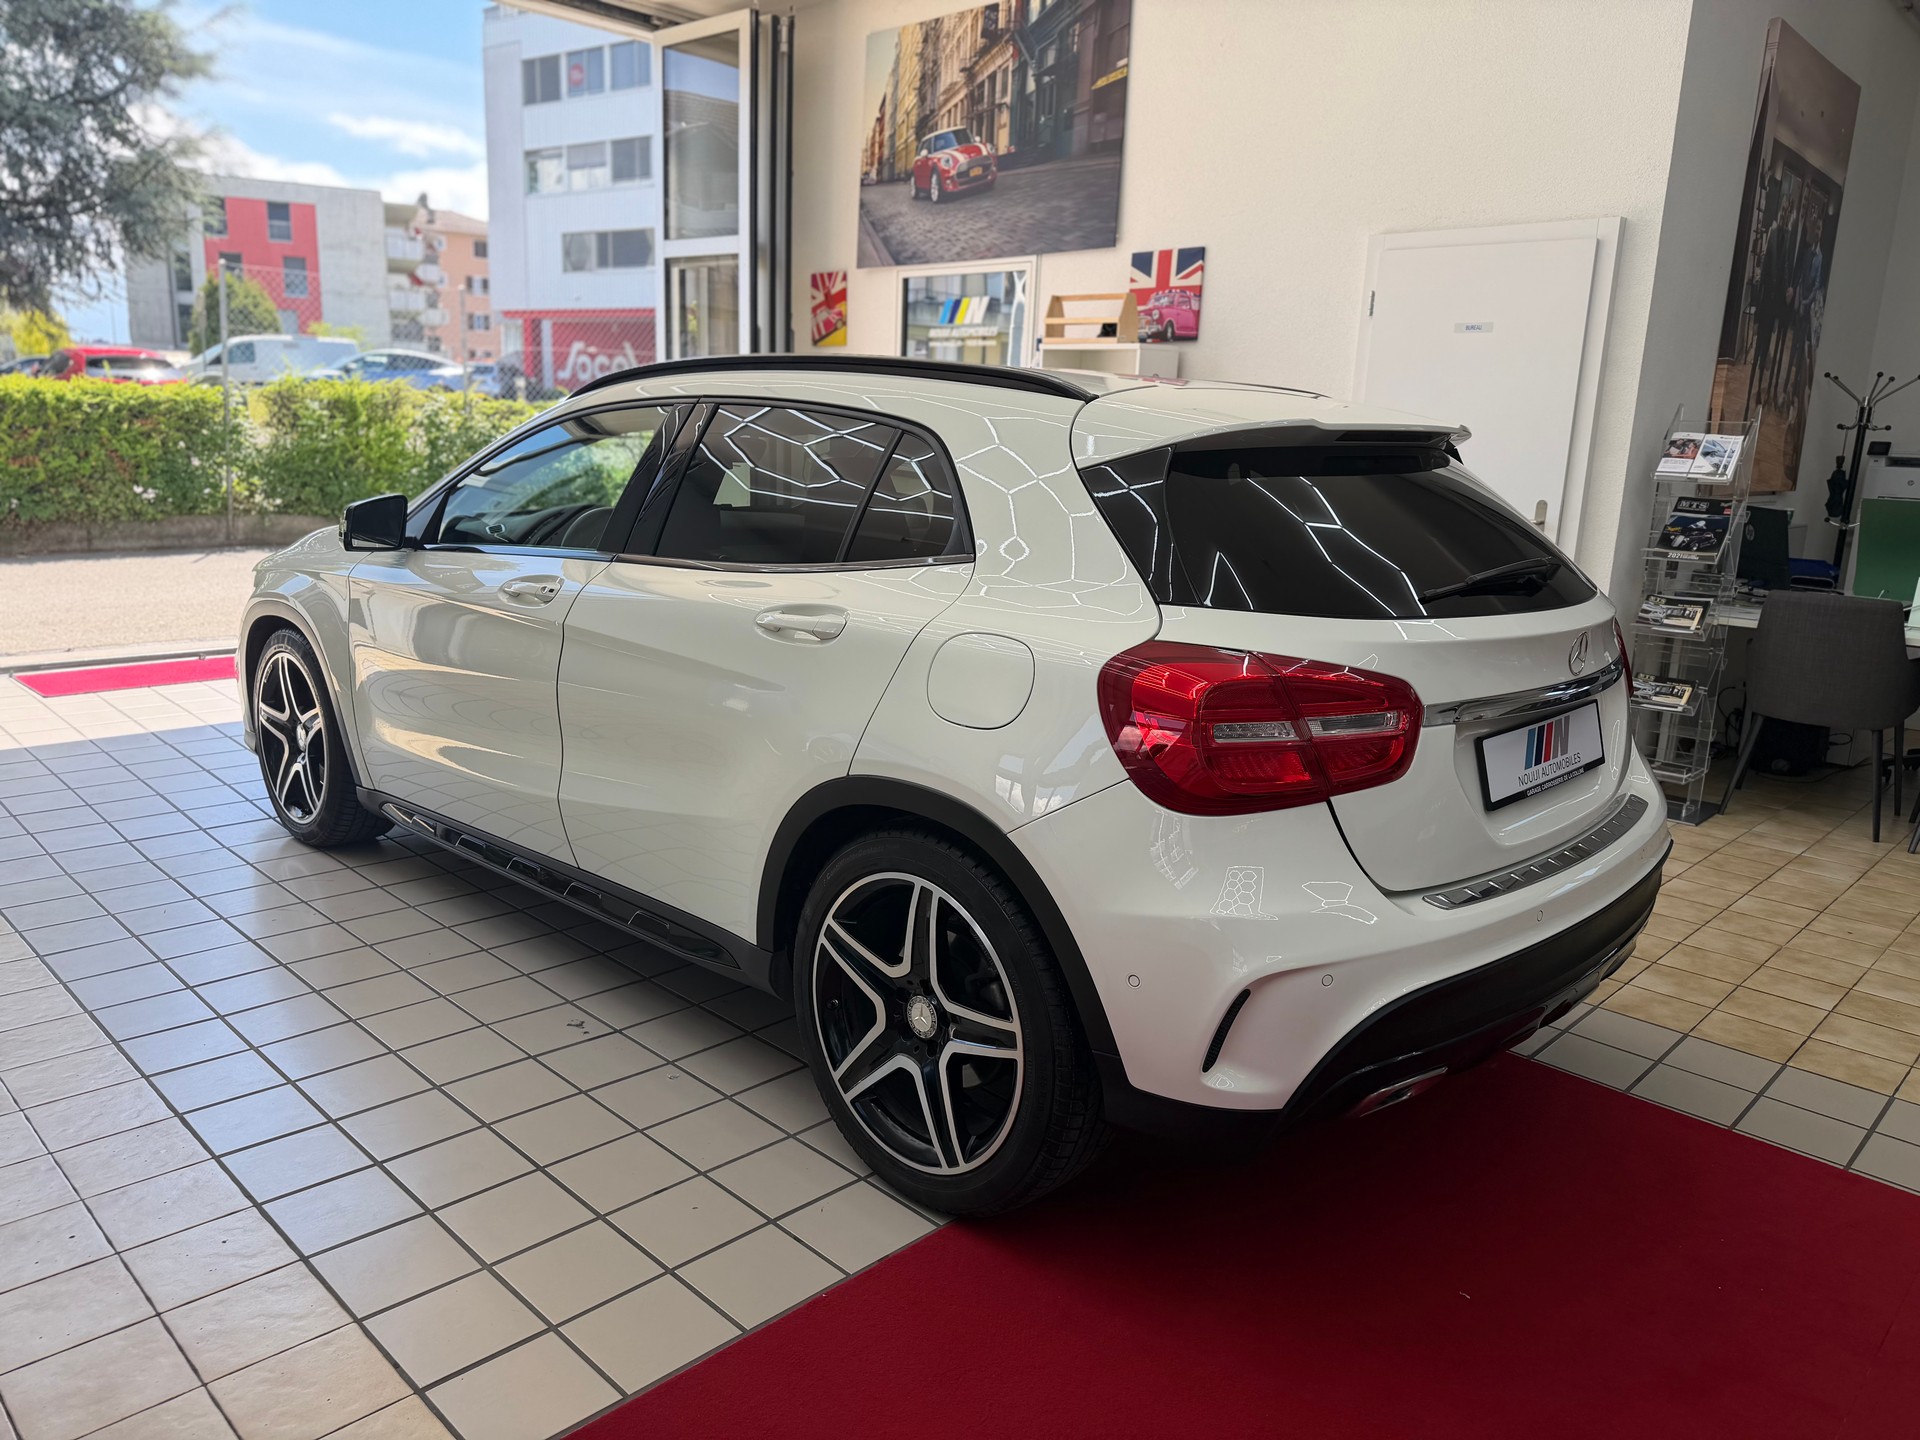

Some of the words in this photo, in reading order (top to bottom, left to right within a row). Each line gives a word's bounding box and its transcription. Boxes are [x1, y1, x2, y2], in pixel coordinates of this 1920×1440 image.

[1679, 500, 1708, 509] MTS
[1541, 752, 1582, 777] AUTOMOBILES
[1527, 786, 1541, 796] GARAGE
